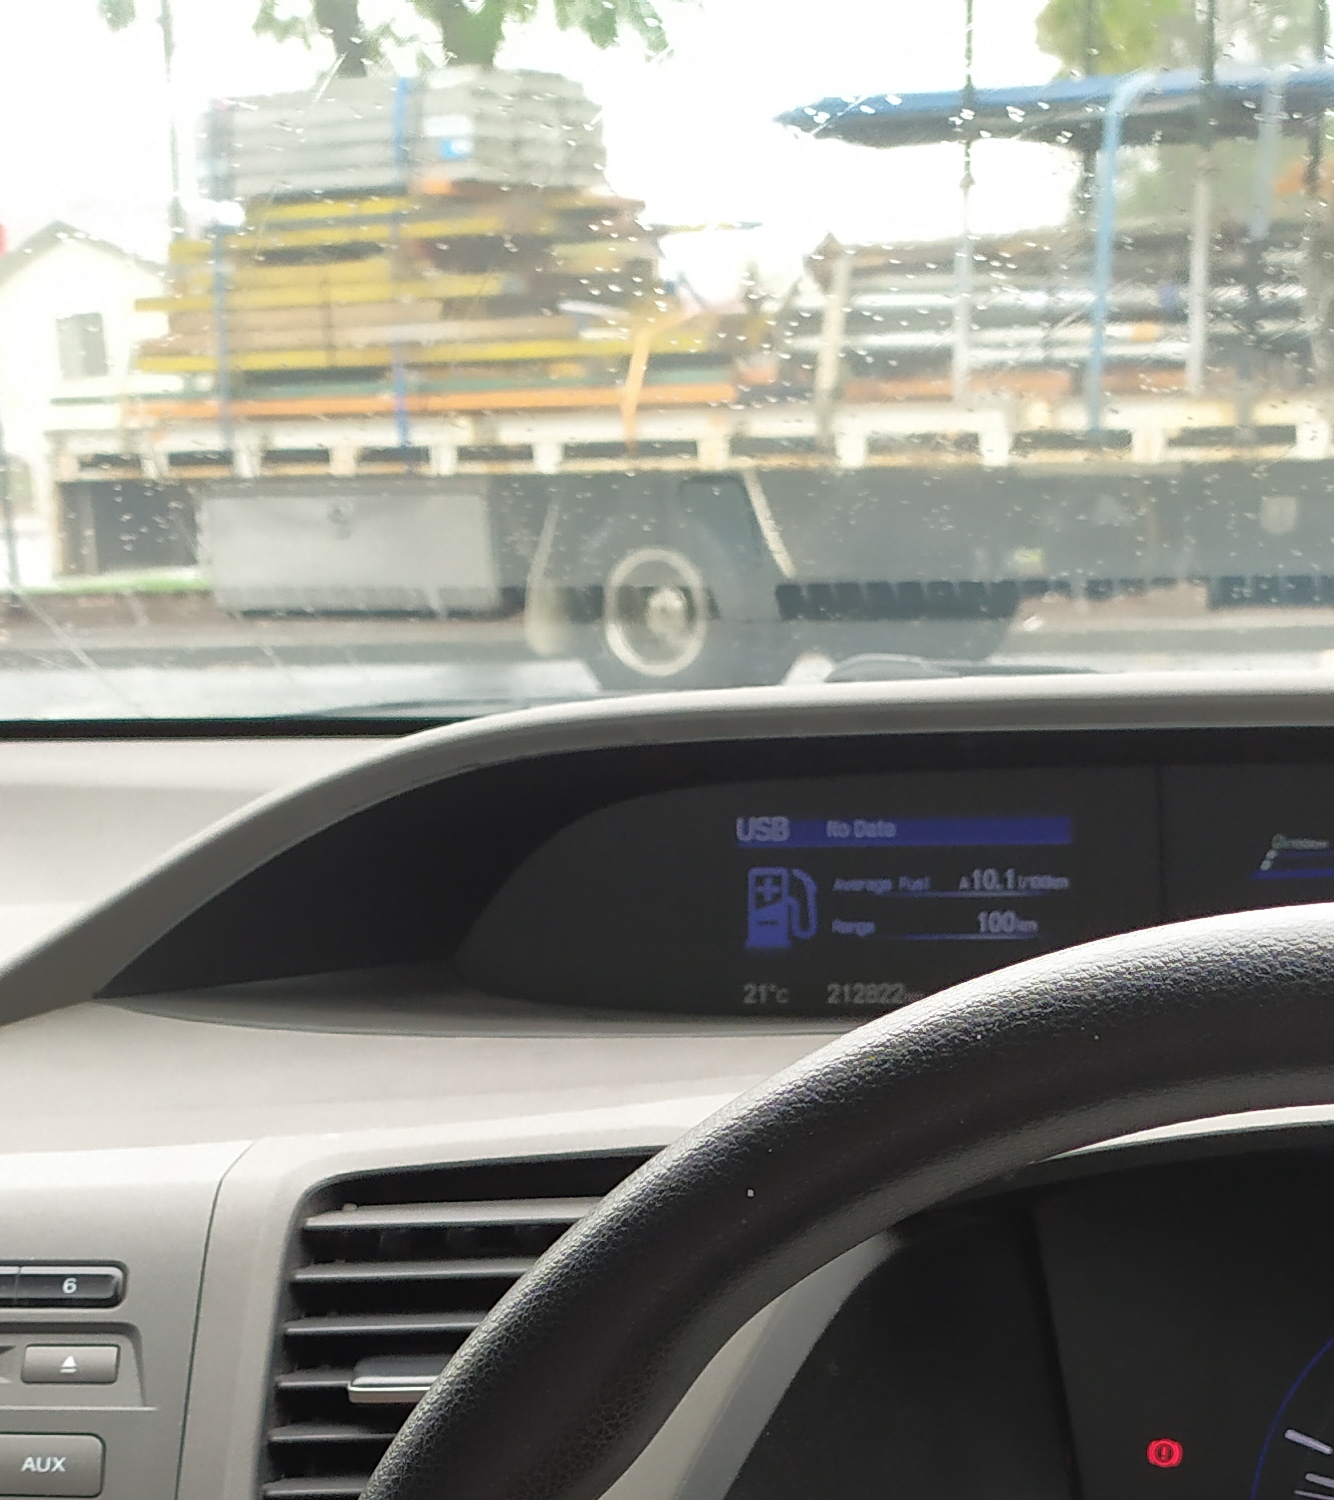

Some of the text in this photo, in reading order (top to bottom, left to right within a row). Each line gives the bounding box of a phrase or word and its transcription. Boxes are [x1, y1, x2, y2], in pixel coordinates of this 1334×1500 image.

[736, 816, 791, 842] USB
[62, 1278, 77, 1294] 6
[21, 1456, 66, 1473] AUX
